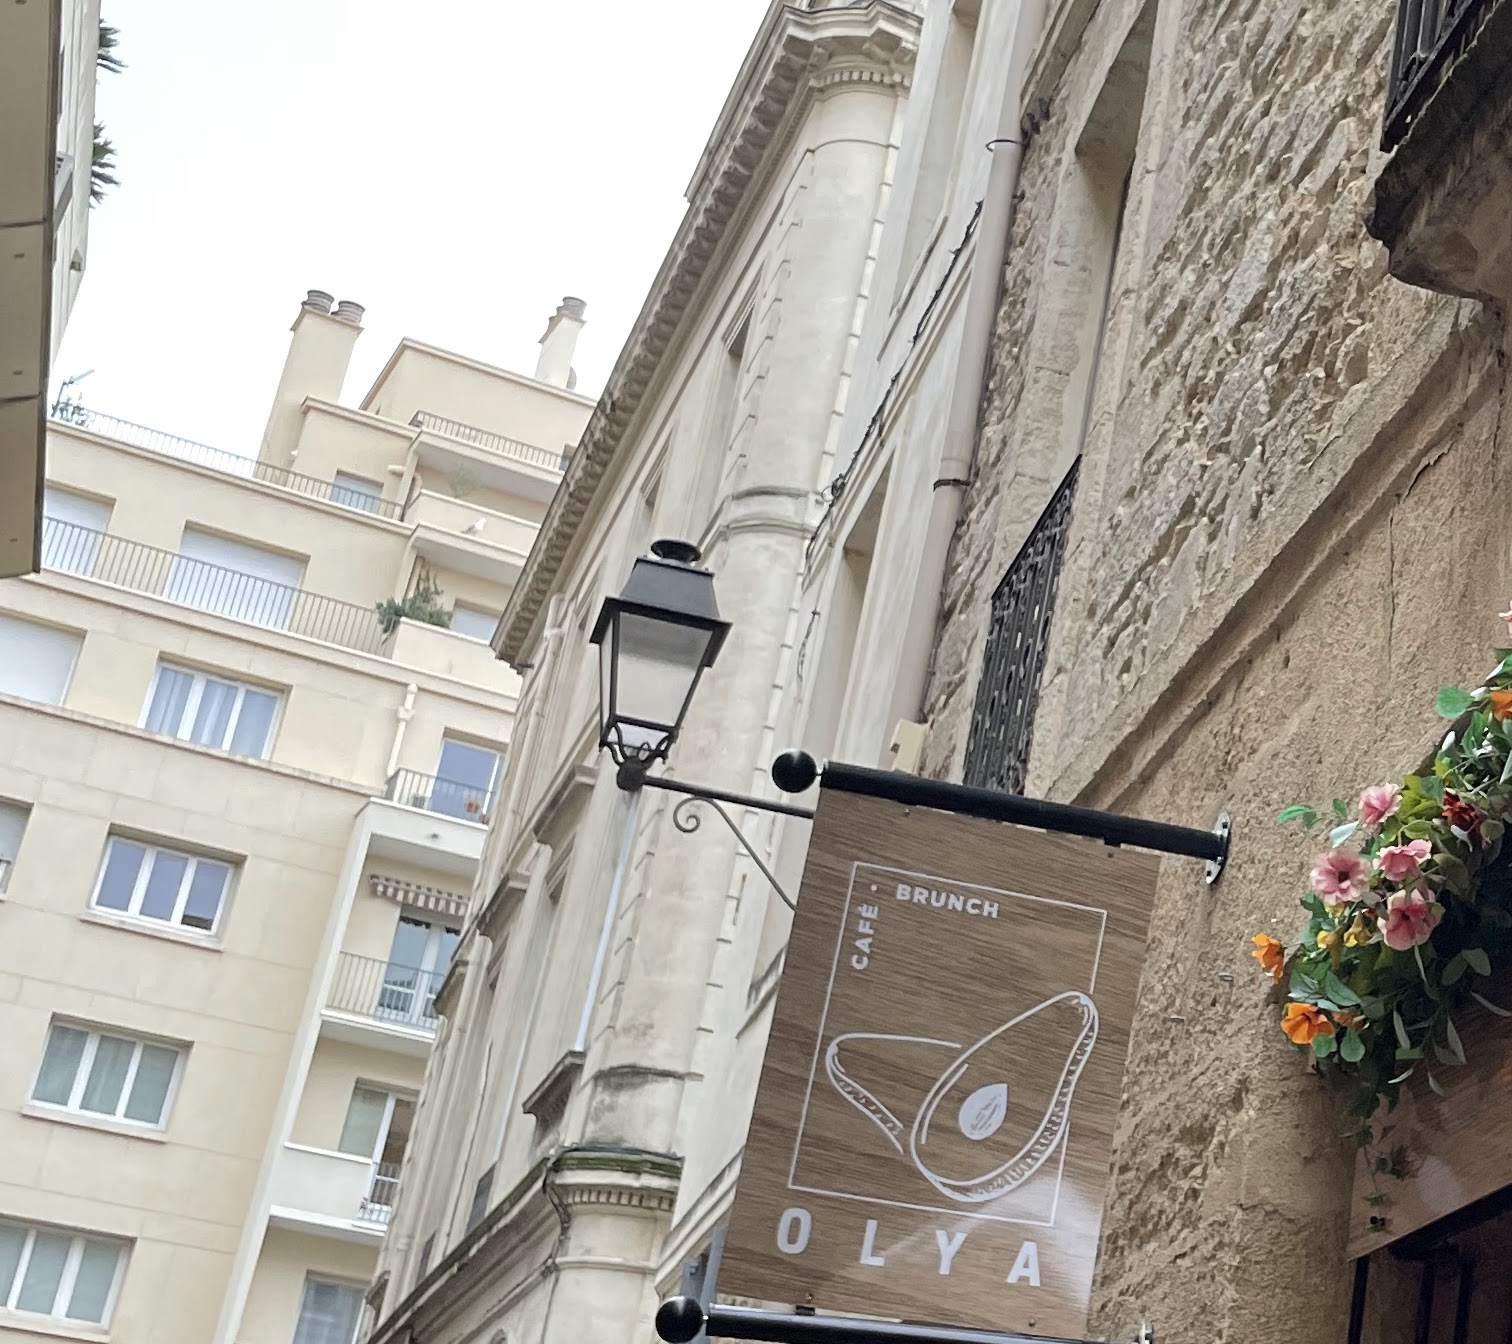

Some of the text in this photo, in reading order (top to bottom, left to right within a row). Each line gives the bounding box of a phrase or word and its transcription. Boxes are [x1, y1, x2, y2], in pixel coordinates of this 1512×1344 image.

[896, 883, 1000, 919] BRUNCH
[851, 903, 879, 970] CAFÉ
[776, 1207, 1042, 1287] OLYA
